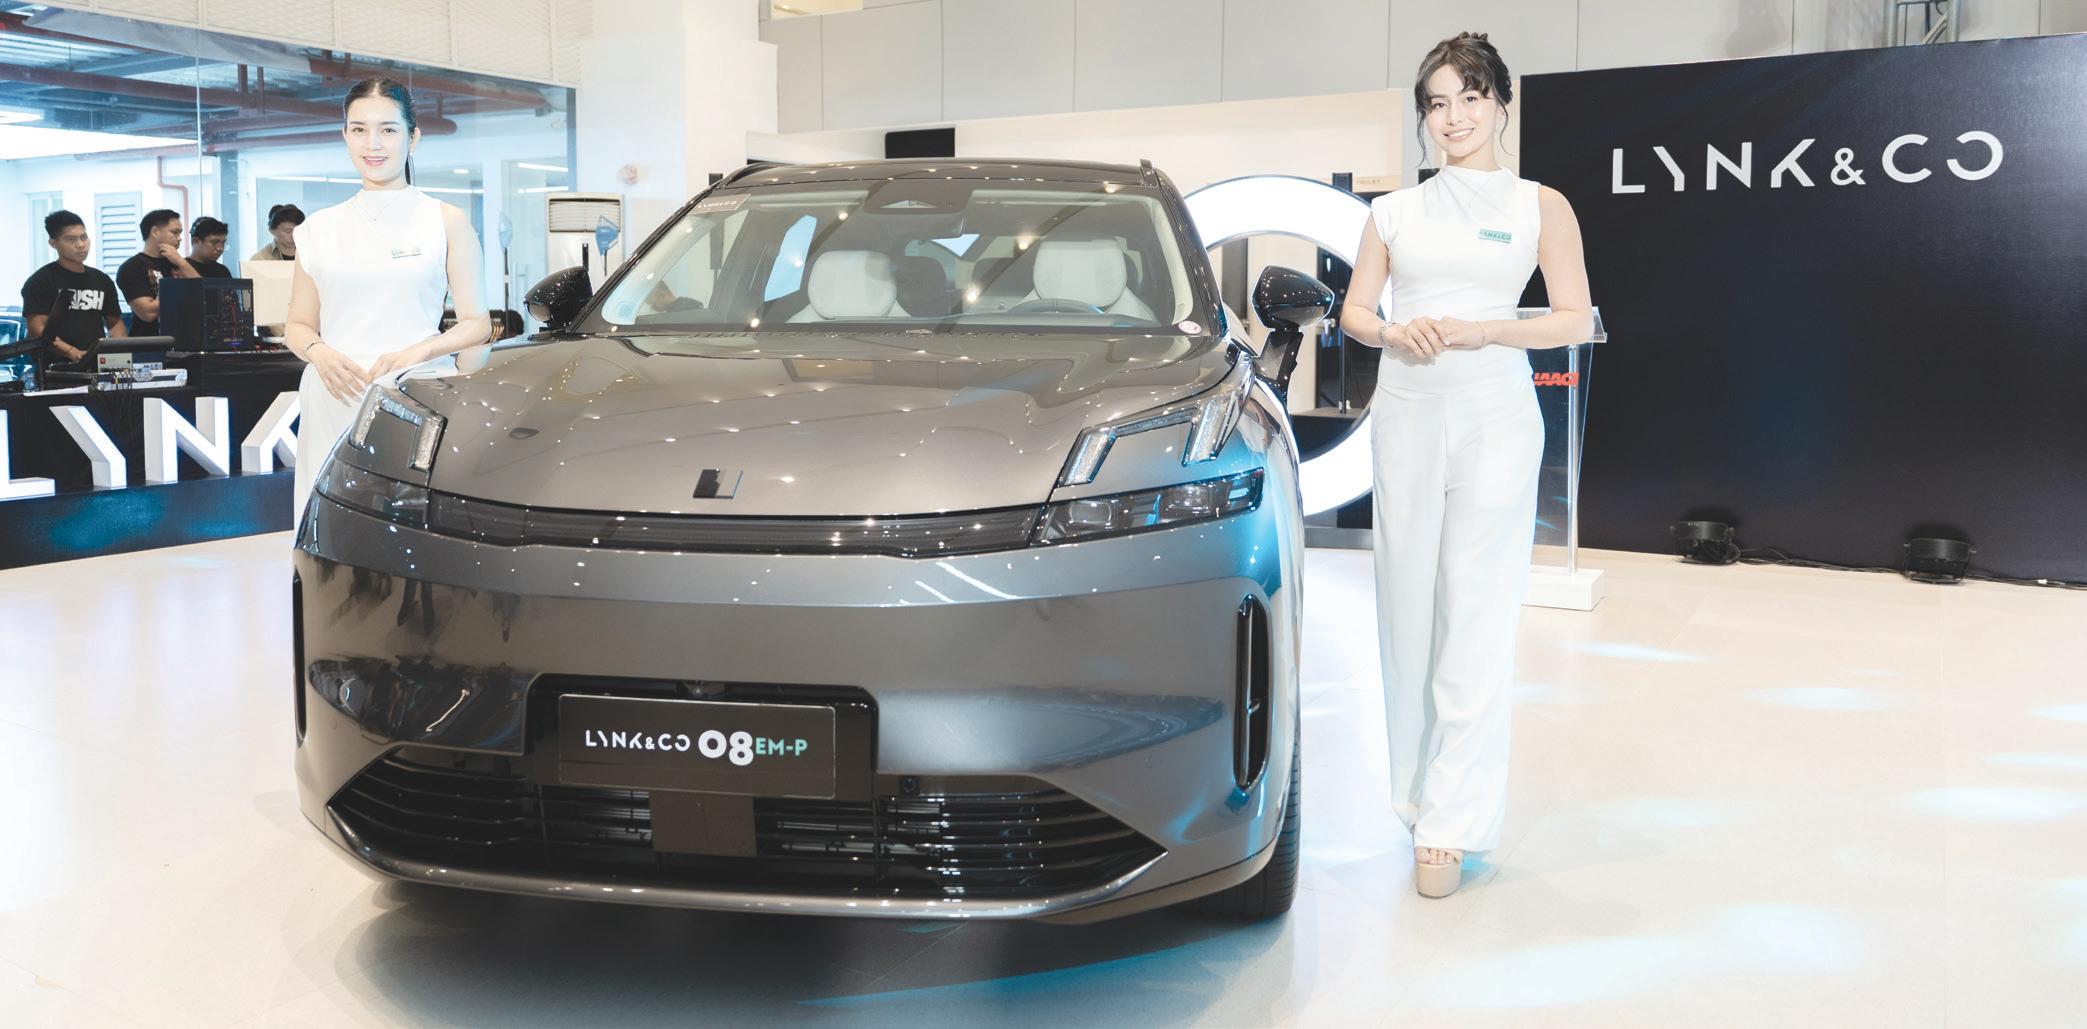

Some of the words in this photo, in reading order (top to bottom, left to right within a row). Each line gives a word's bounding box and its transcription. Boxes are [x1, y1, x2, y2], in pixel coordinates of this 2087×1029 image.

[1612, 130, 2004, 194] LYNK&CO
[698, 729, 754, 766] 08
[755, 737, 808, 756] EM-P
